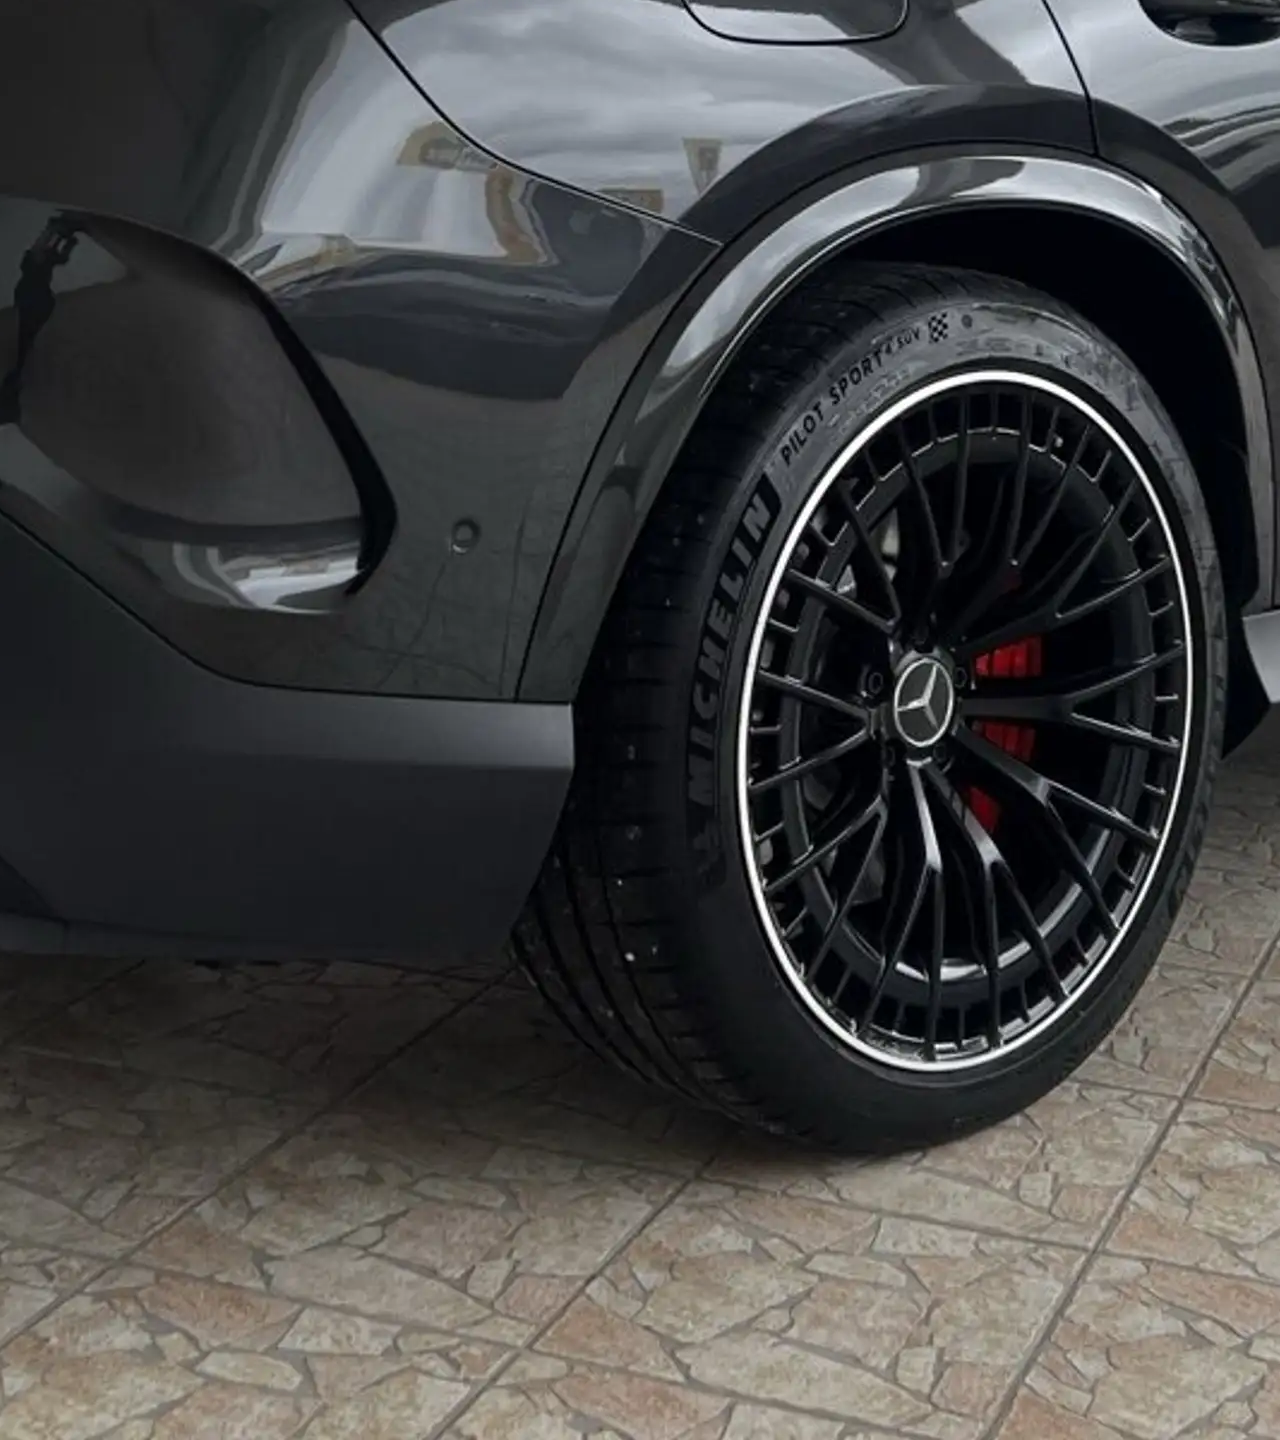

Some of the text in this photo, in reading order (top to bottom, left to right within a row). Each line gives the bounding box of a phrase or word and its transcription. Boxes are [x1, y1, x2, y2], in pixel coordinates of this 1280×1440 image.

[780, 401, 824, 466] PILOT
[829, 349, 883, 405] SPORT
[896, 326, 922, 349] SUV
[687, 491, 772, 808] MICHELIN
